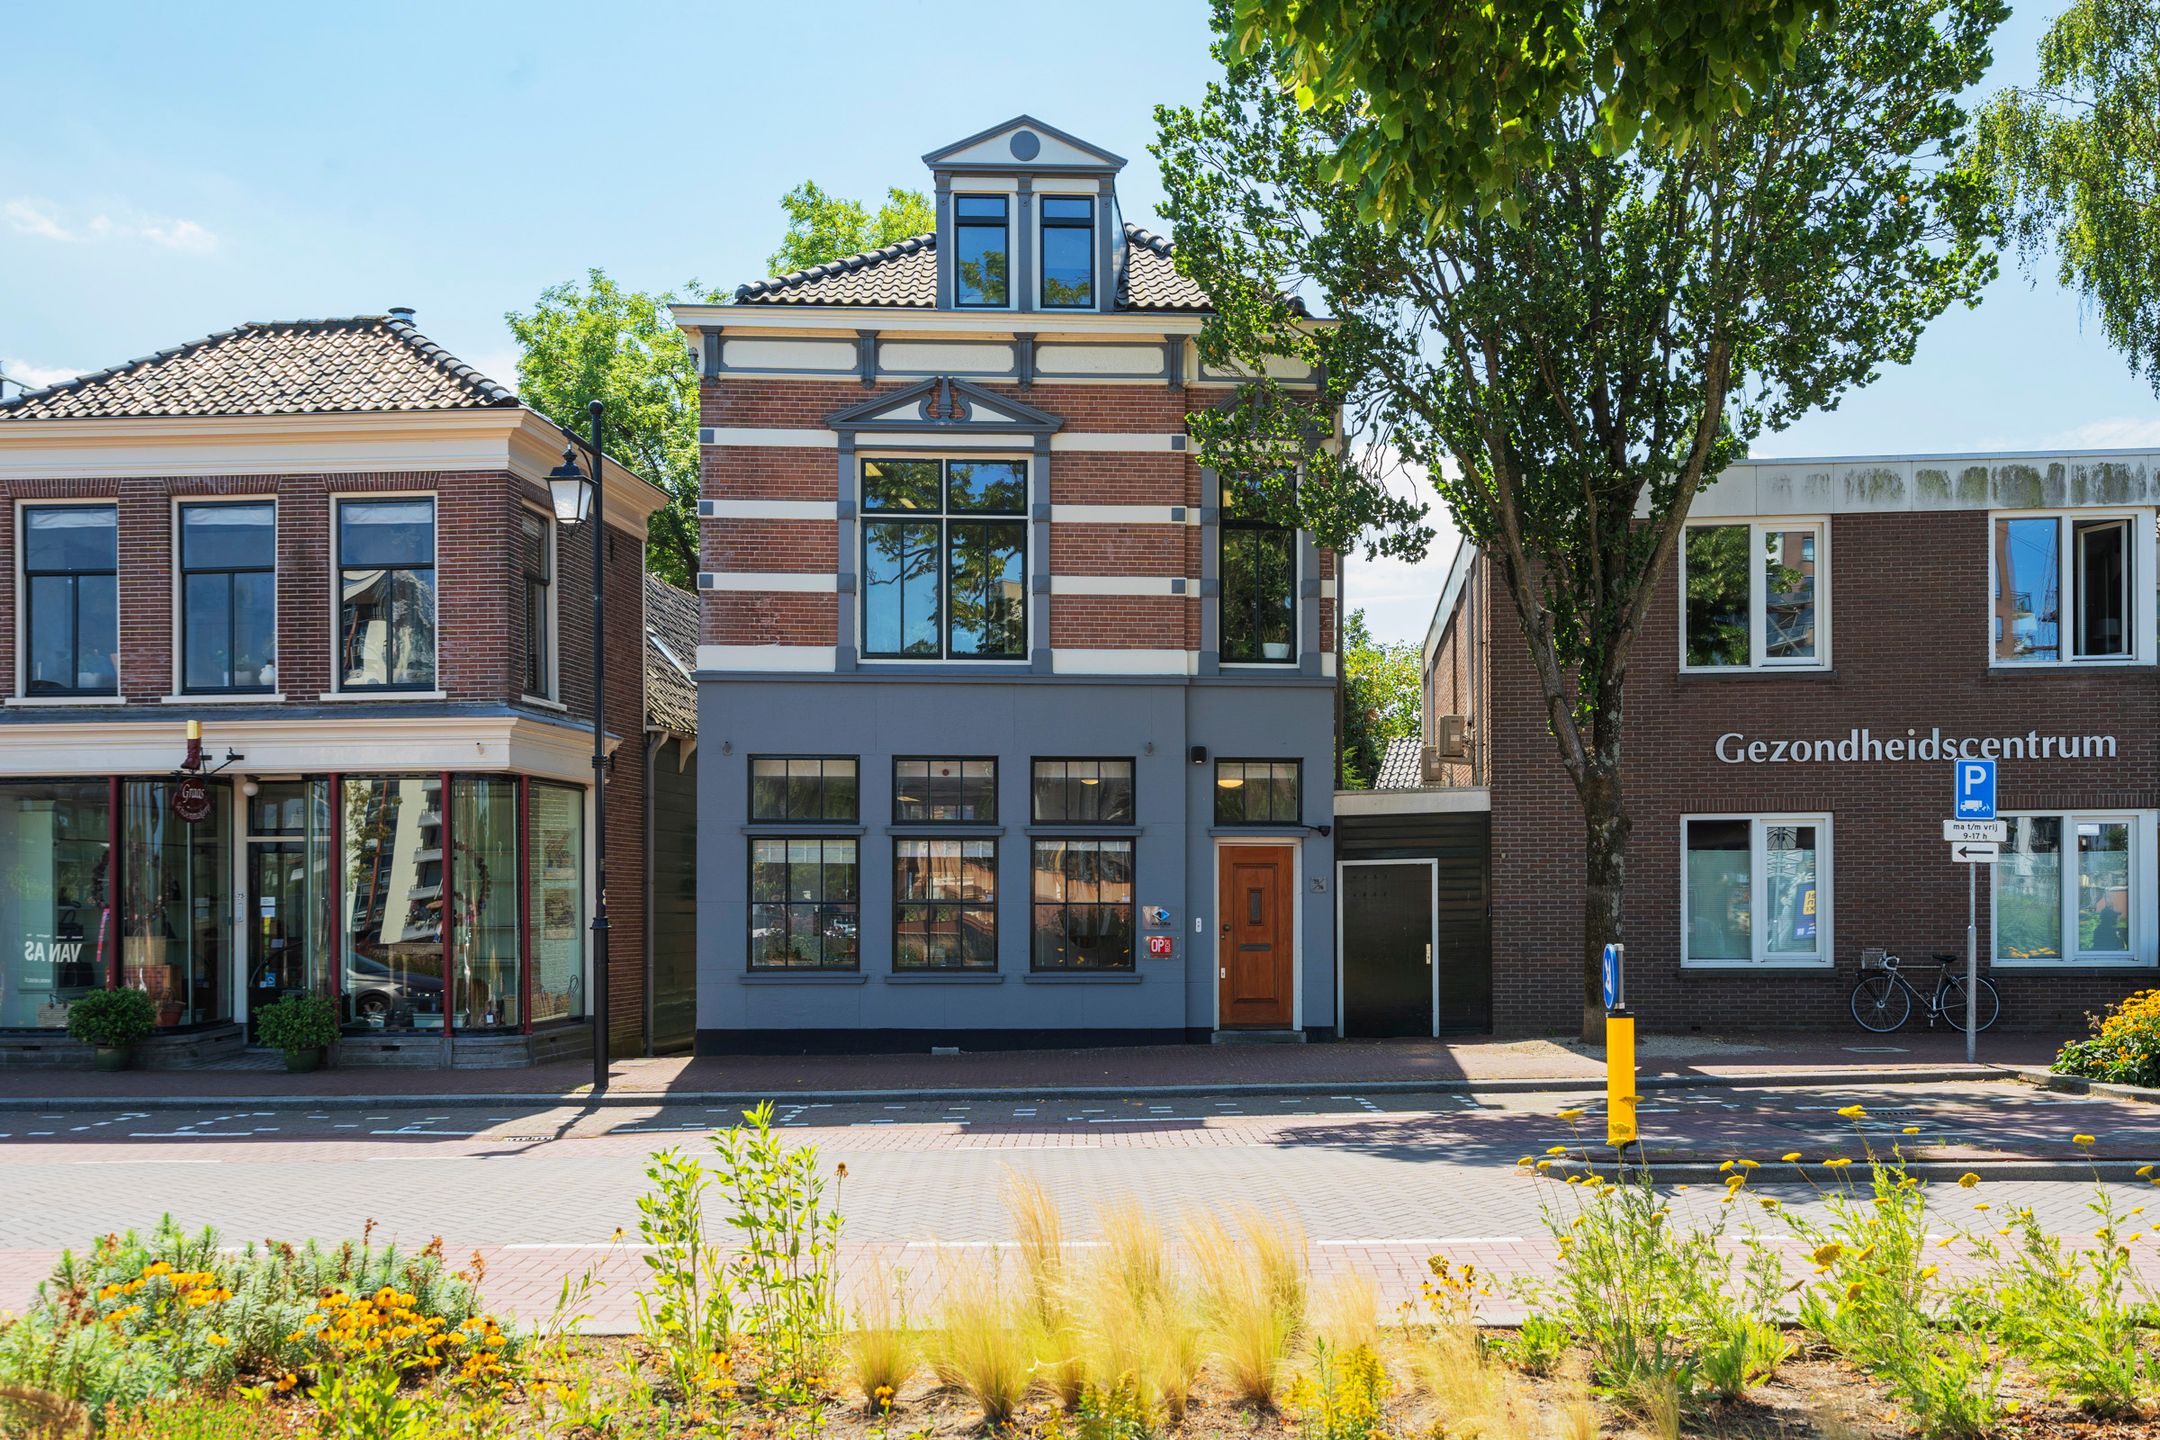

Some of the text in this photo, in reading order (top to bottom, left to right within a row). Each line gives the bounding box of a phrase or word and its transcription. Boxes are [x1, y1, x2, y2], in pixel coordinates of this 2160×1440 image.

[1715, 727, 2117, 763] Gezondheidscentrum
[1965, 765, 1987, 795] P
[1953, 823, 1998, 832] ma t/m vrij
[1963, 832, 1988, 840] 9-17 h
[1151, 938, 1165, 953] OP
